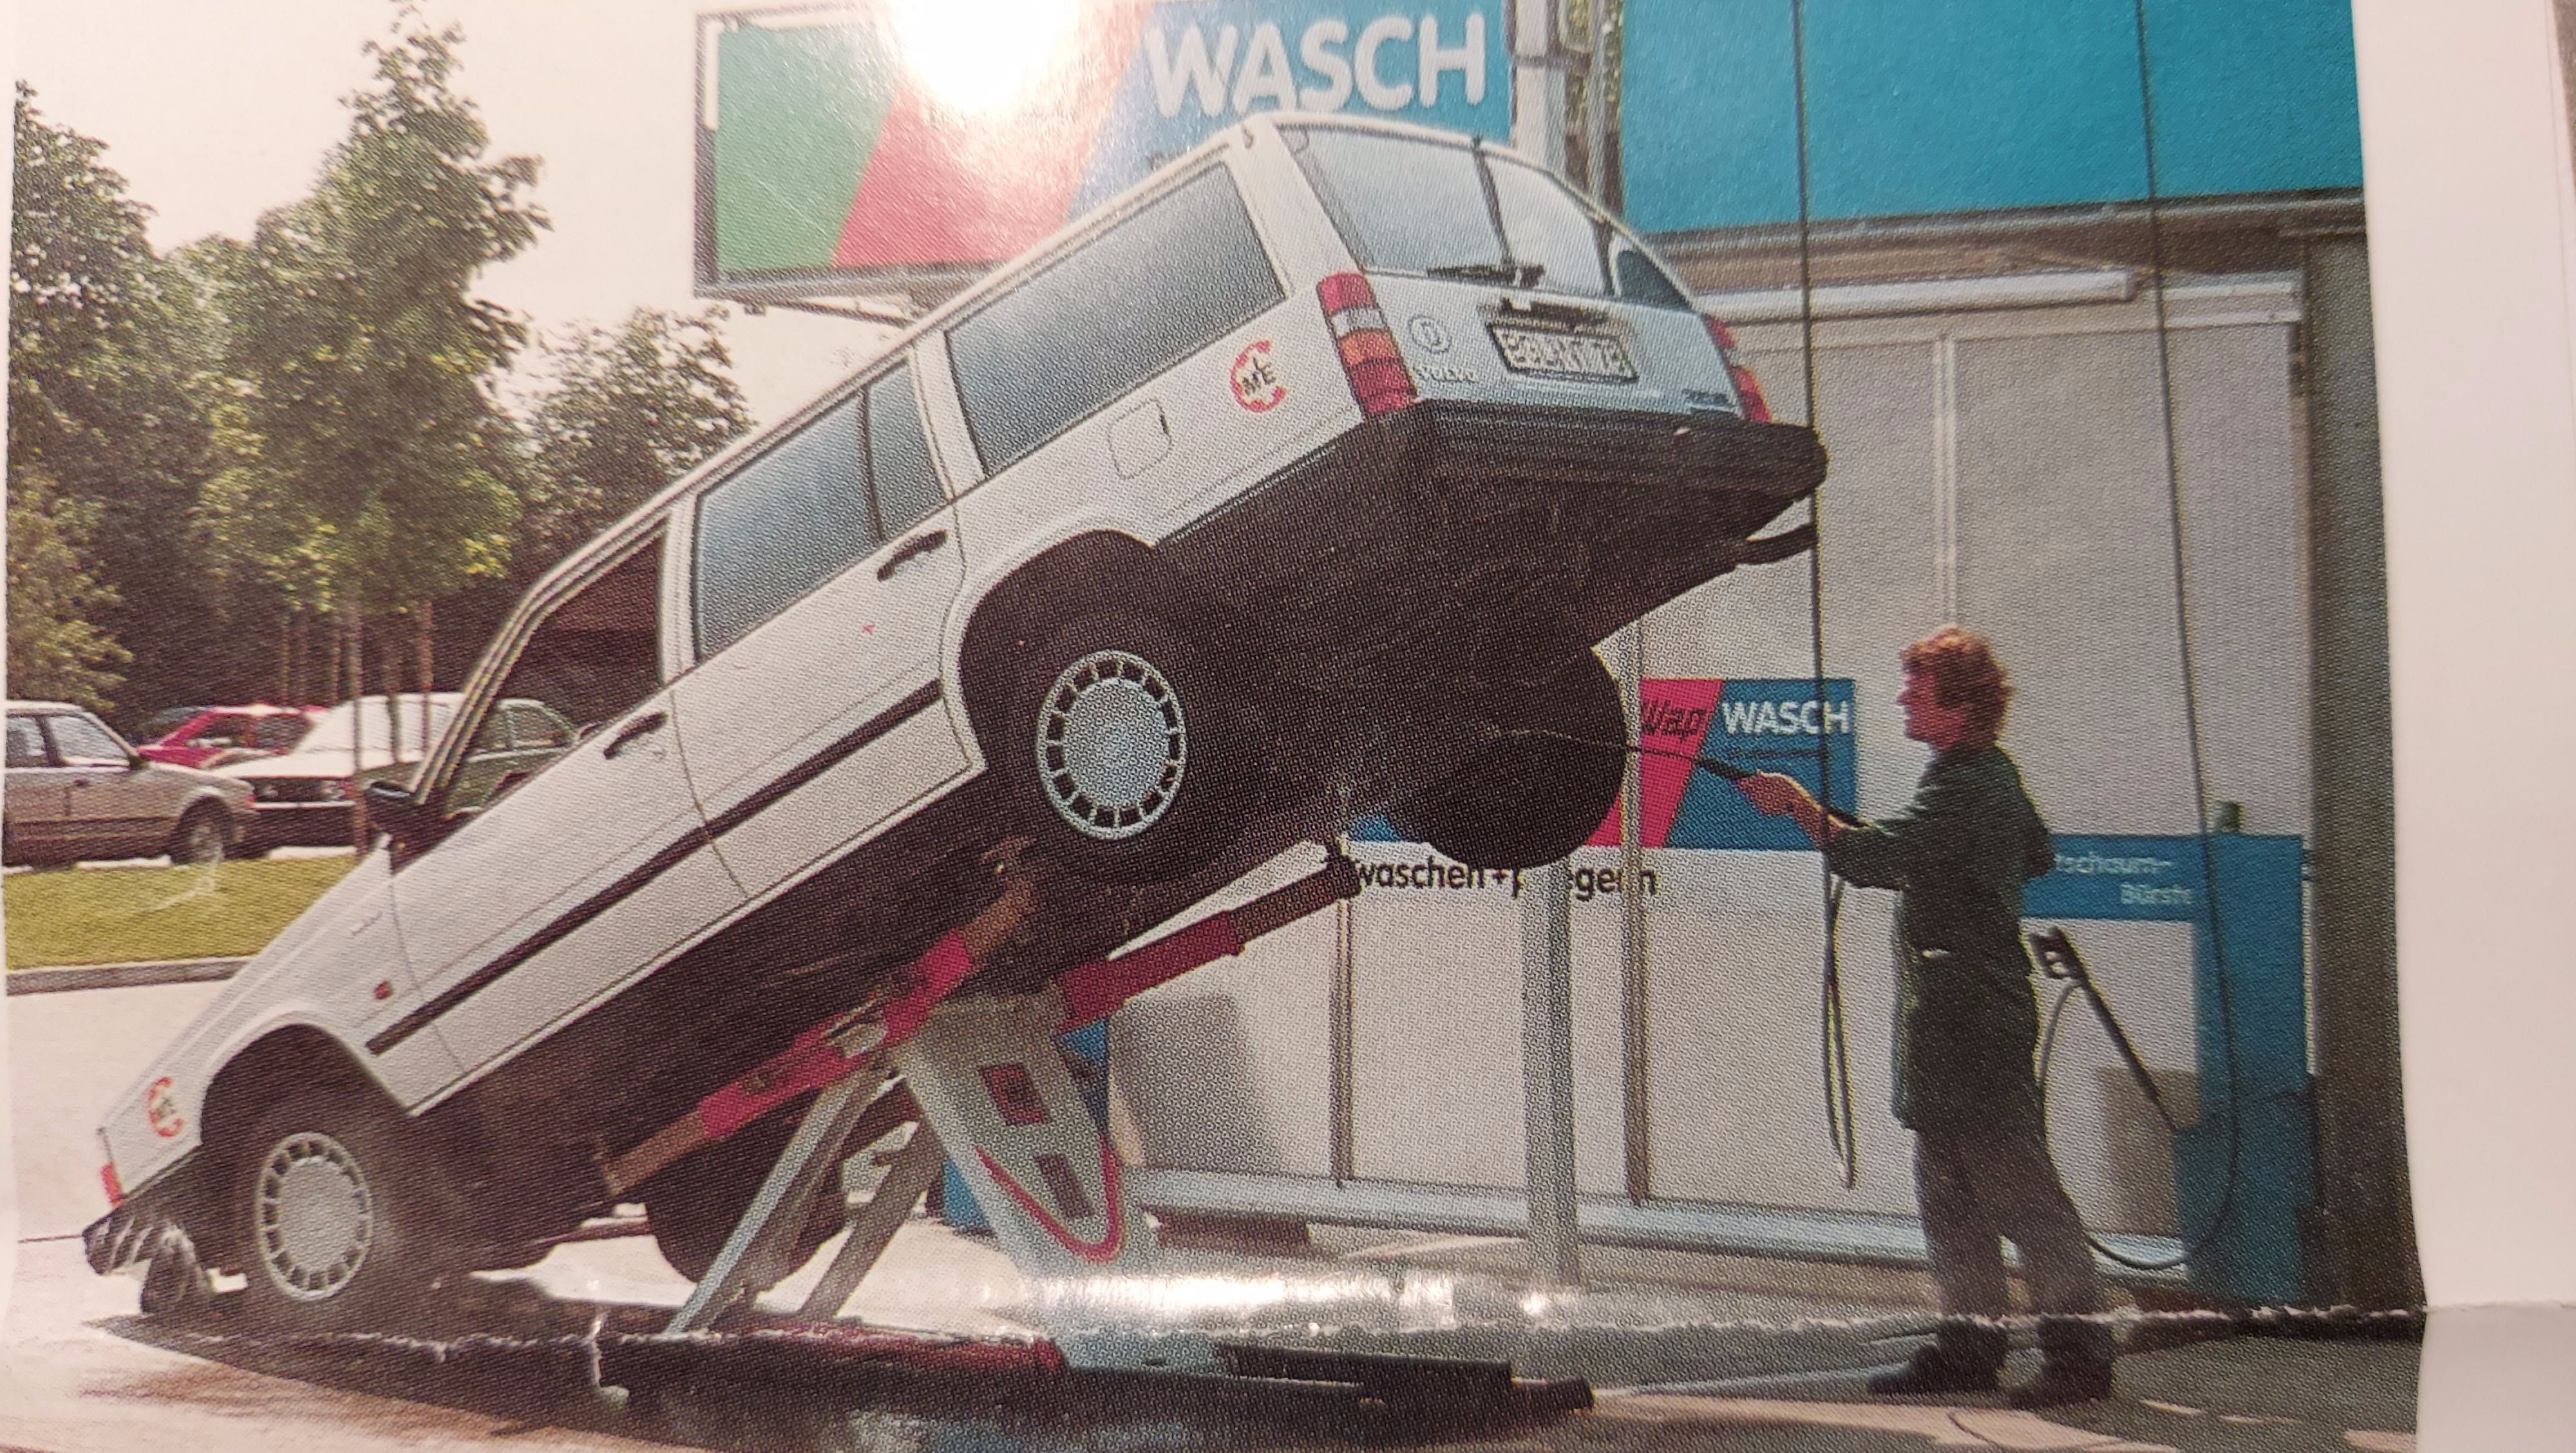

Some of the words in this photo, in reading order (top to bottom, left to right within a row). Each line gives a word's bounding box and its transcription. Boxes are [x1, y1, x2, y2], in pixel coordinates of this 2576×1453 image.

[1144, 12, 1486, 118] WASCH
[1721, 699, 1850, 735] WASCH
[1356, 855, 1484, 889] waschen
